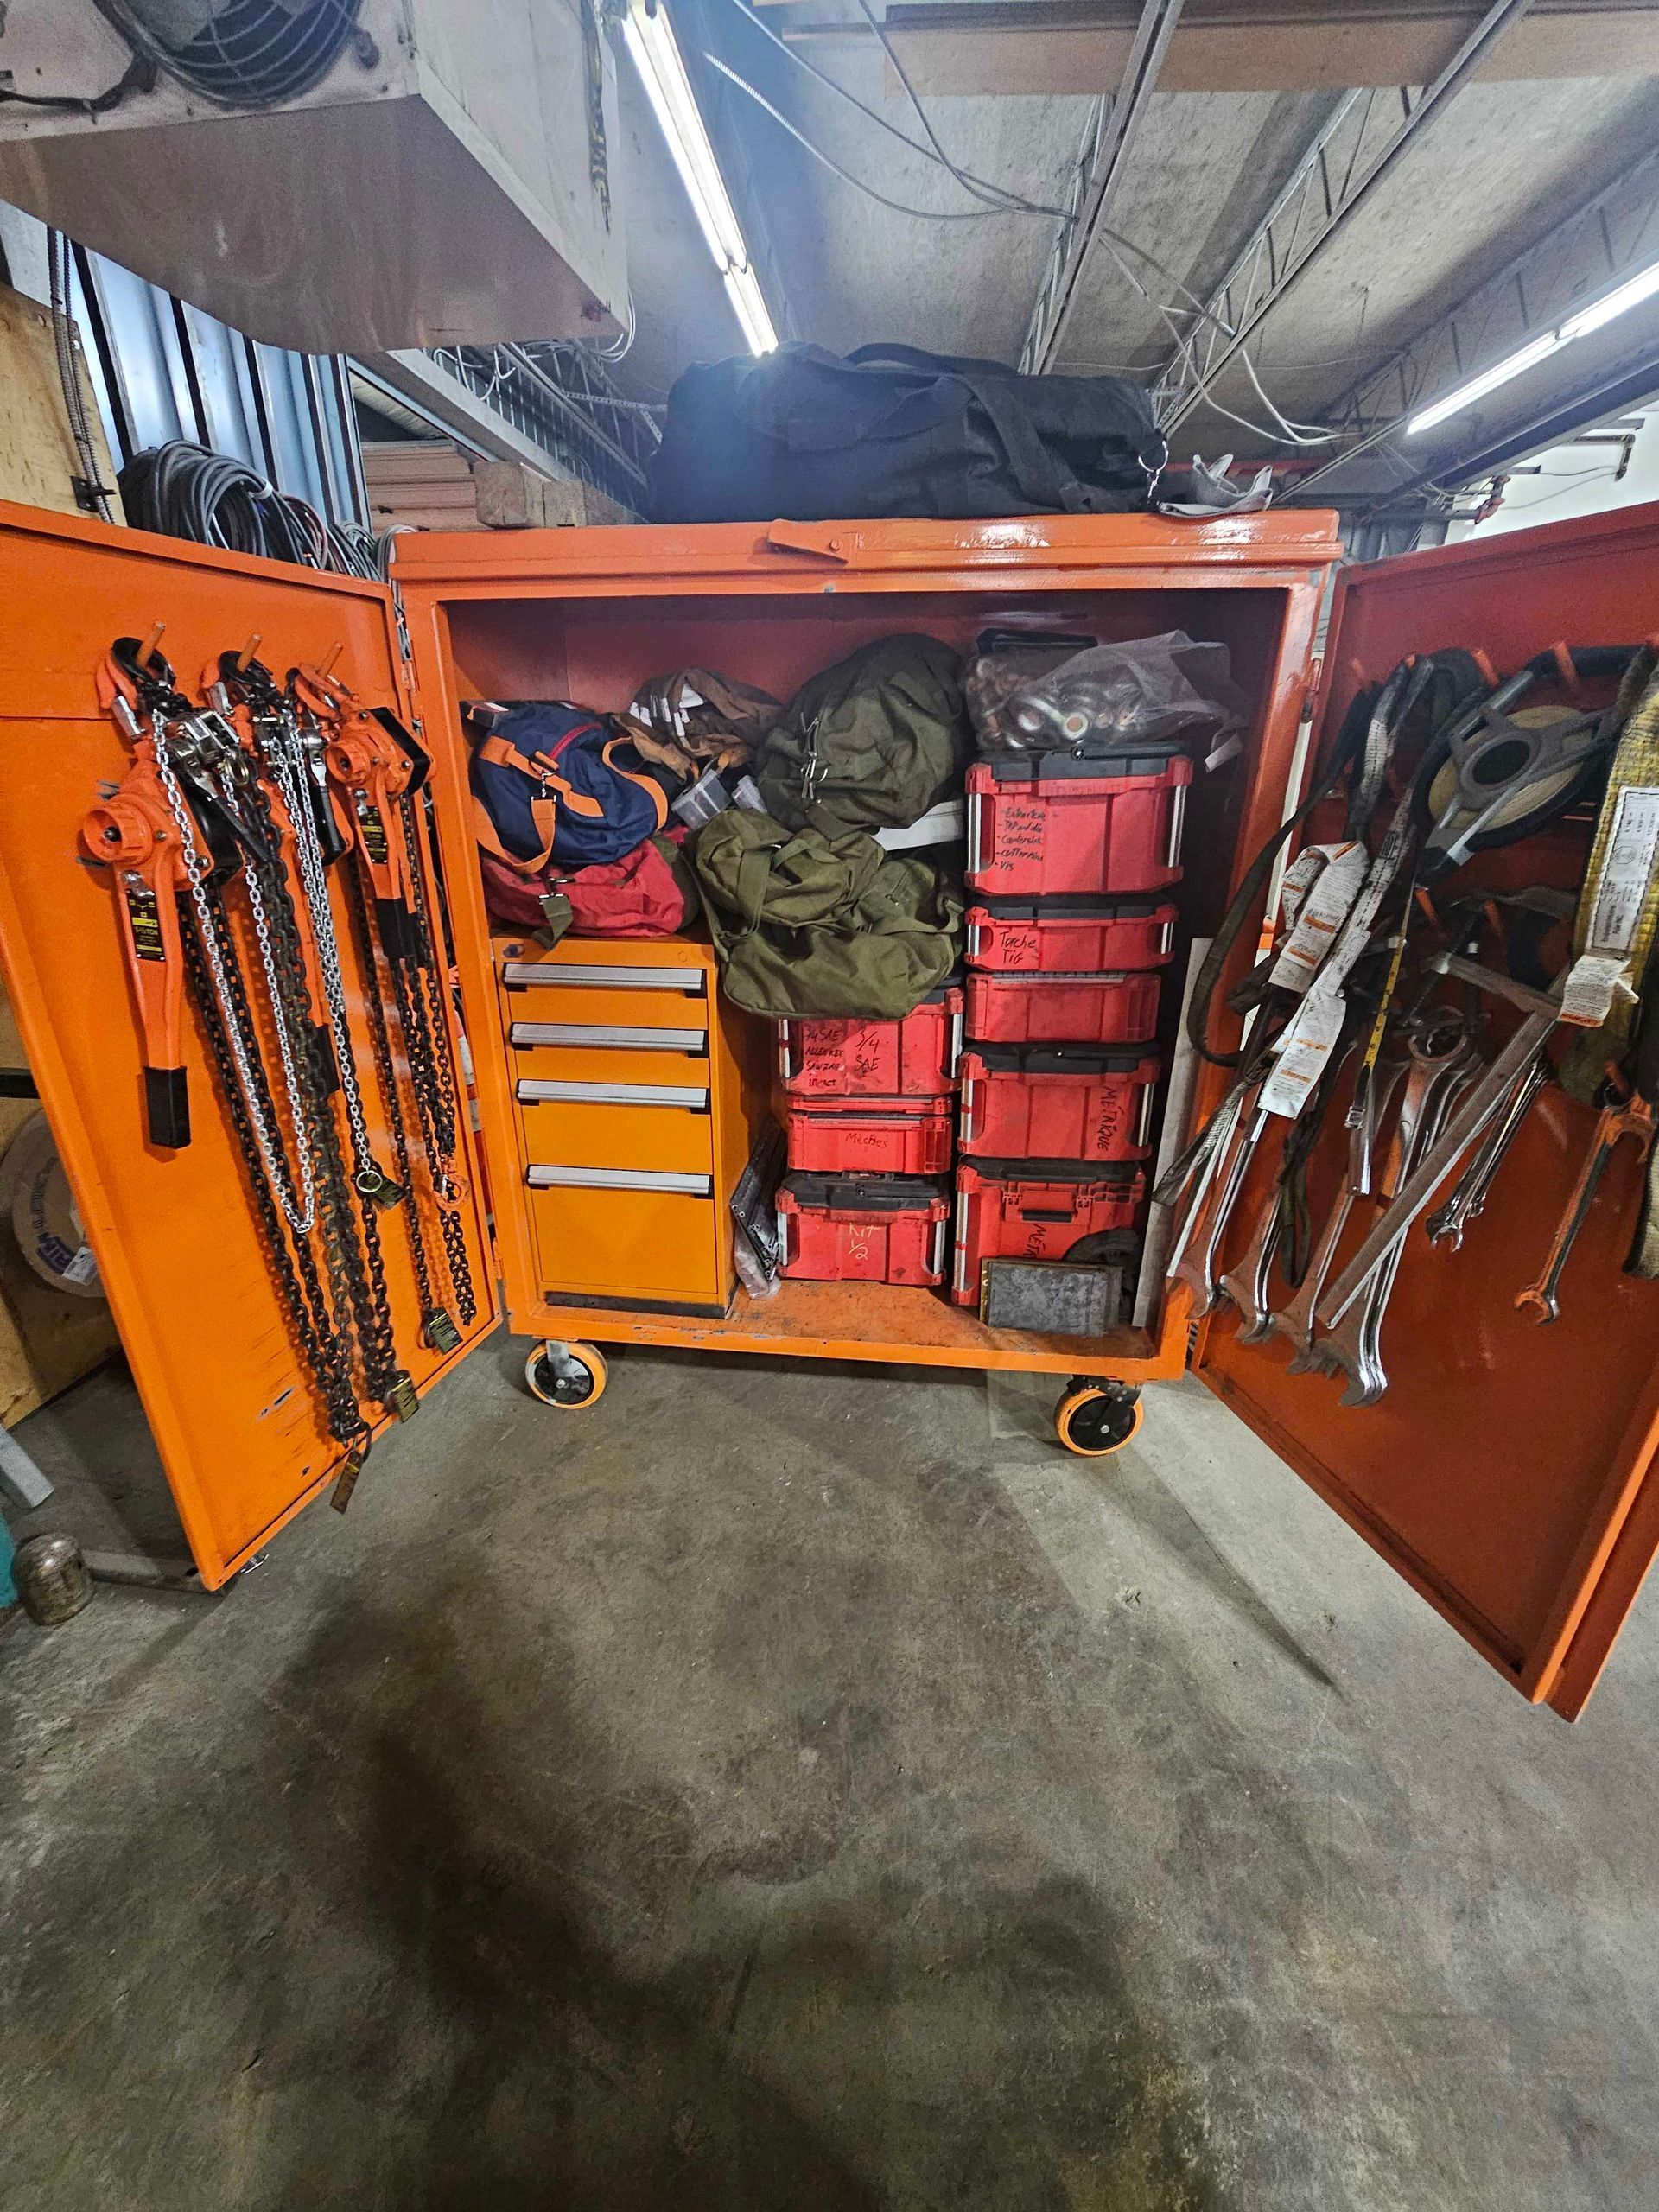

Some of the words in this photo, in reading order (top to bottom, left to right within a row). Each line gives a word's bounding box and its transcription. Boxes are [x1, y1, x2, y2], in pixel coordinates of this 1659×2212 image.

[999, 931, 1037, 949] Tache
[854, 1029, 880, 1054] 3/4
[854, 1054, 881, 1072] SAE
[849, 1238, 869, 1261] 1/2
